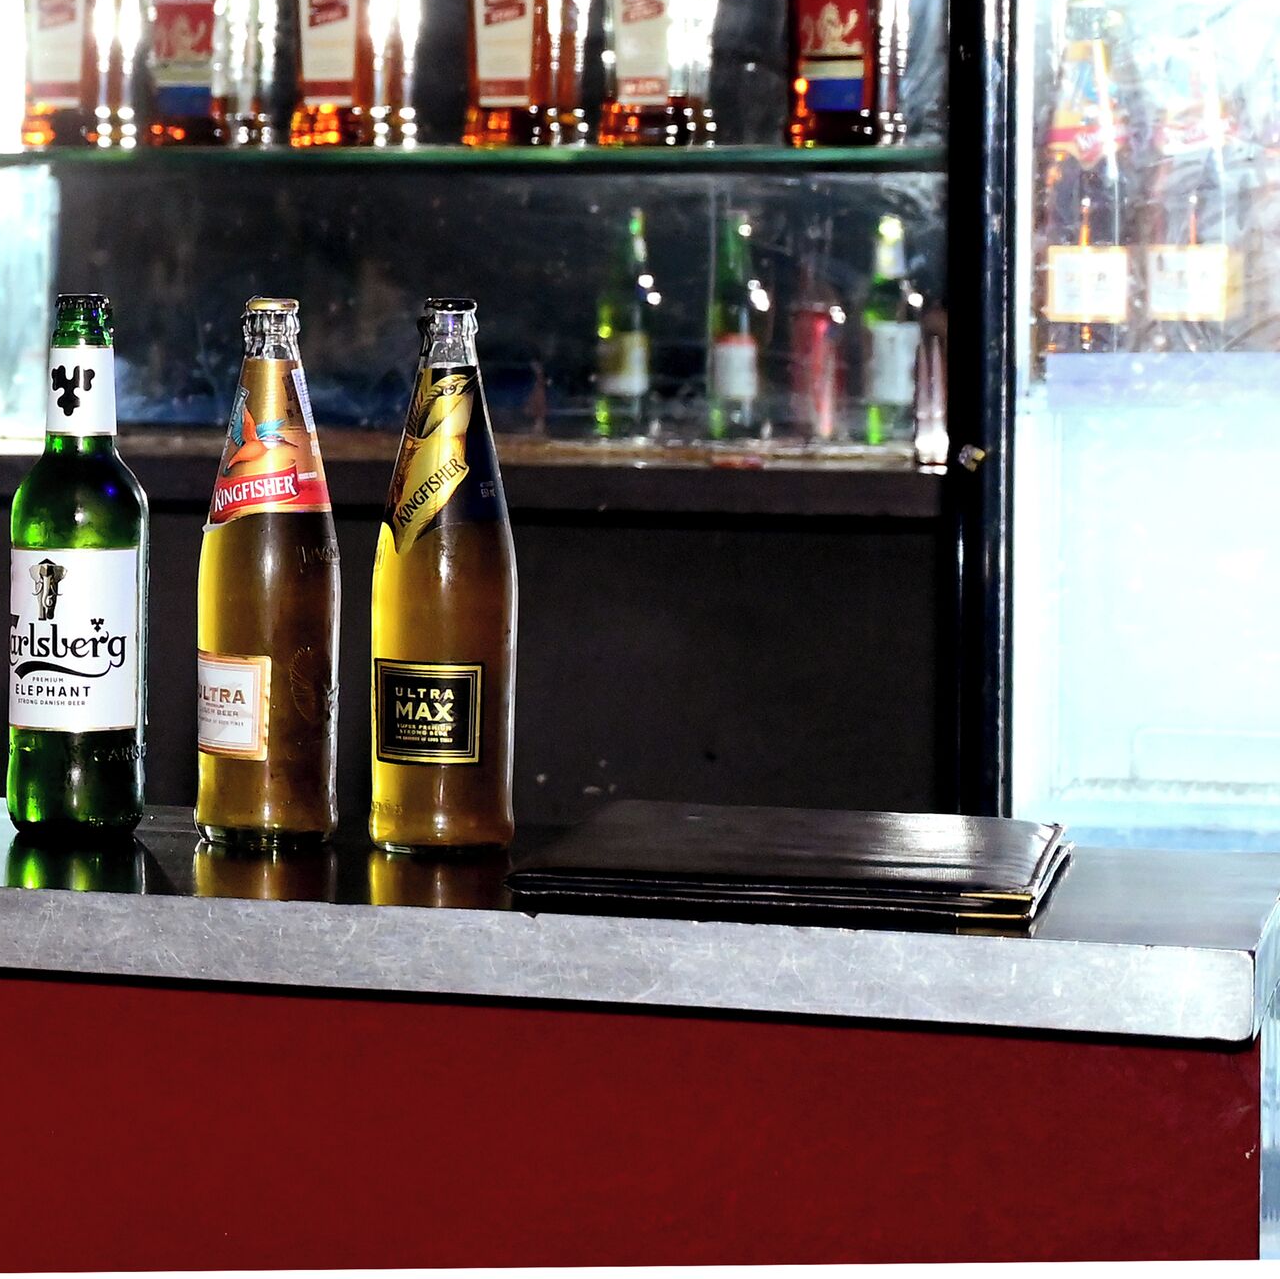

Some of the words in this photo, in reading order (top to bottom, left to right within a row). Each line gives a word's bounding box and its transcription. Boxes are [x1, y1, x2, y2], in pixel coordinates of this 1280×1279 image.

[214, 475, 297, 512] KINGFISHER
[395, 458, 467, 527] KINGFISHER
[15, 683, 91, 697] ELEPHANT
[395, 687, 454, 700] ULTRA
[395, 701, 454, 722] MAX
